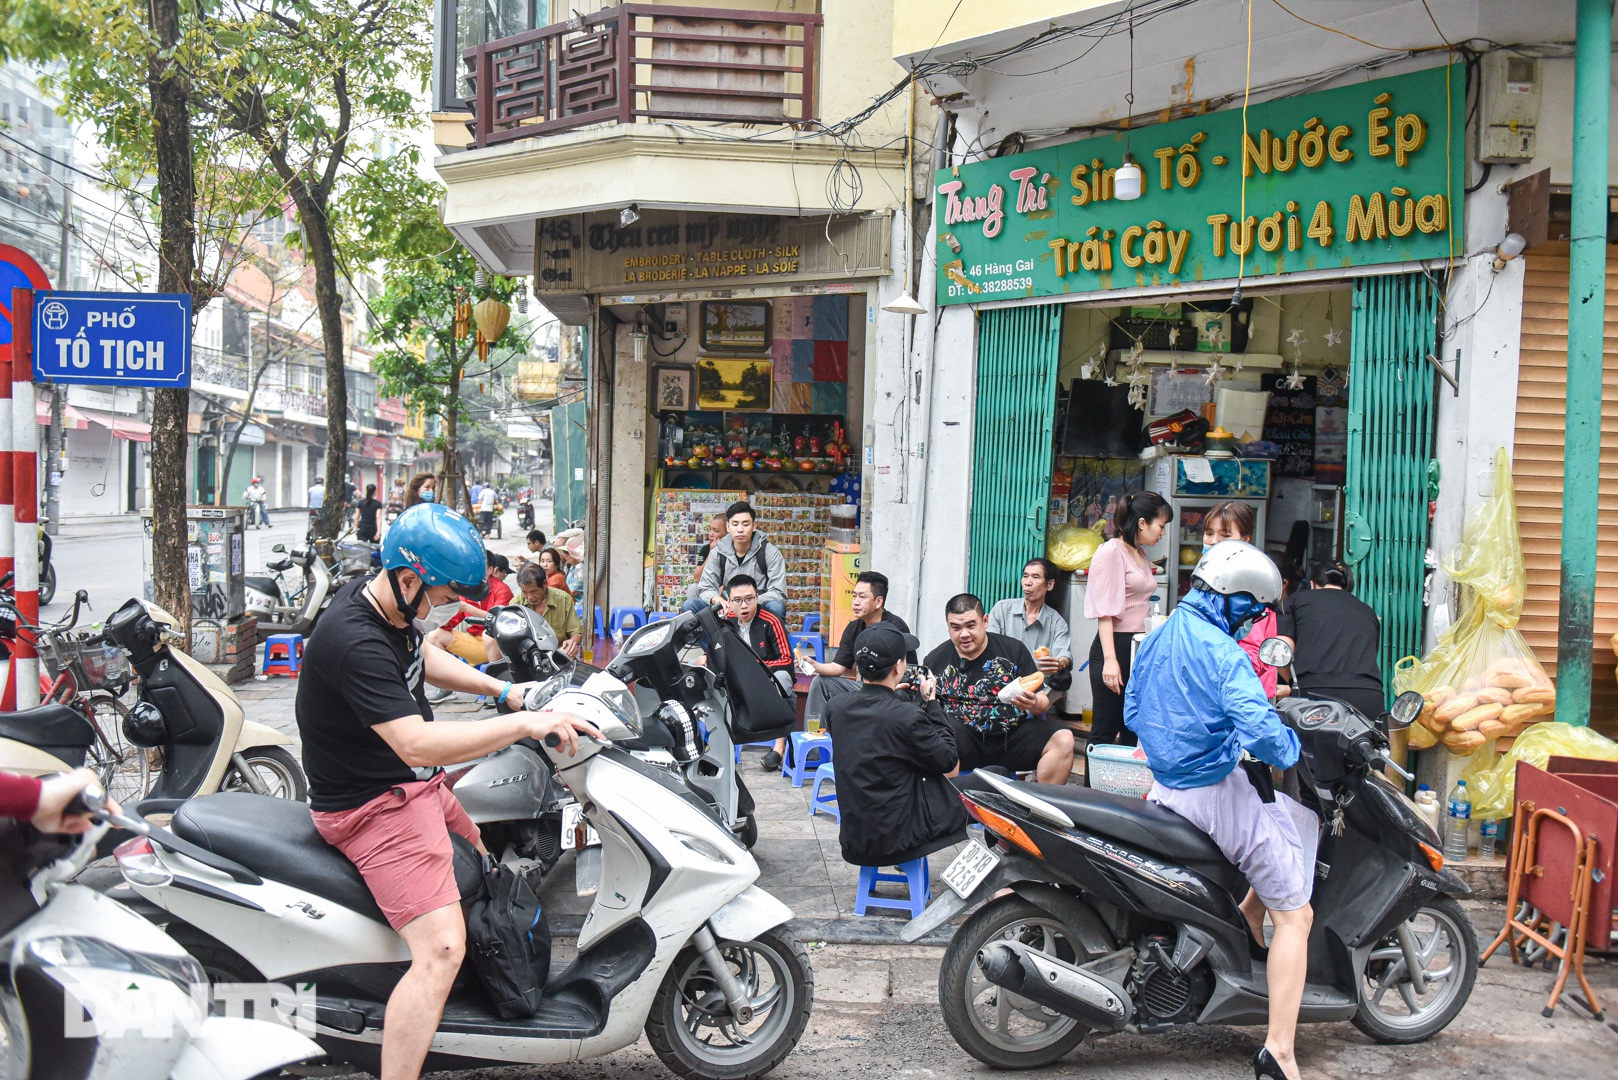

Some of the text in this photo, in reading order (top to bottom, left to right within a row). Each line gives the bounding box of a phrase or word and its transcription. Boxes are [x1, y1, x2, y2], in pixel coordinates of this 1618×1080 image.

[1071, 157, 1146, 206] Sin
[1154, 131, 1207, 190] Tố
[1242, 116, 1354, 178] Nước
[1368, 92, 1428, 167] Ép
[937, 166, 1051, 239] Trang Trí
[1048, 186, 1448, 278] Trái Cây Tươi 4 Mùa
[623, 252, 688, 269] EMBROIDERY
[696, 250, 729, 264] TABLE
[731, 246, 767, 261] CLOTH
[774, 244, 800, 258] SILK
[969, 265, 983, 277] 46
[984, 262, 1013, 277] Hàng
[1015, 258, 1035, 272] Gai
[623, 270, 638, 283] LA
[639, 267, 687, 282] BRODERIE
[694, 266, 709, 279] LA
[711, 263, 748, 277] NAPPE
[755, 262, 770, 274] LA
[772, 260, 798, 273] SOIE
[947, 276, 1033, 297] ĐT: 04.38288539
[87, 305, 136, 329] PHỐ
[56, 326, 165, 376] TỐ TỊCH
[489, 773, 529, 788] LEAD
[946, 860, 976, 892] 5258
